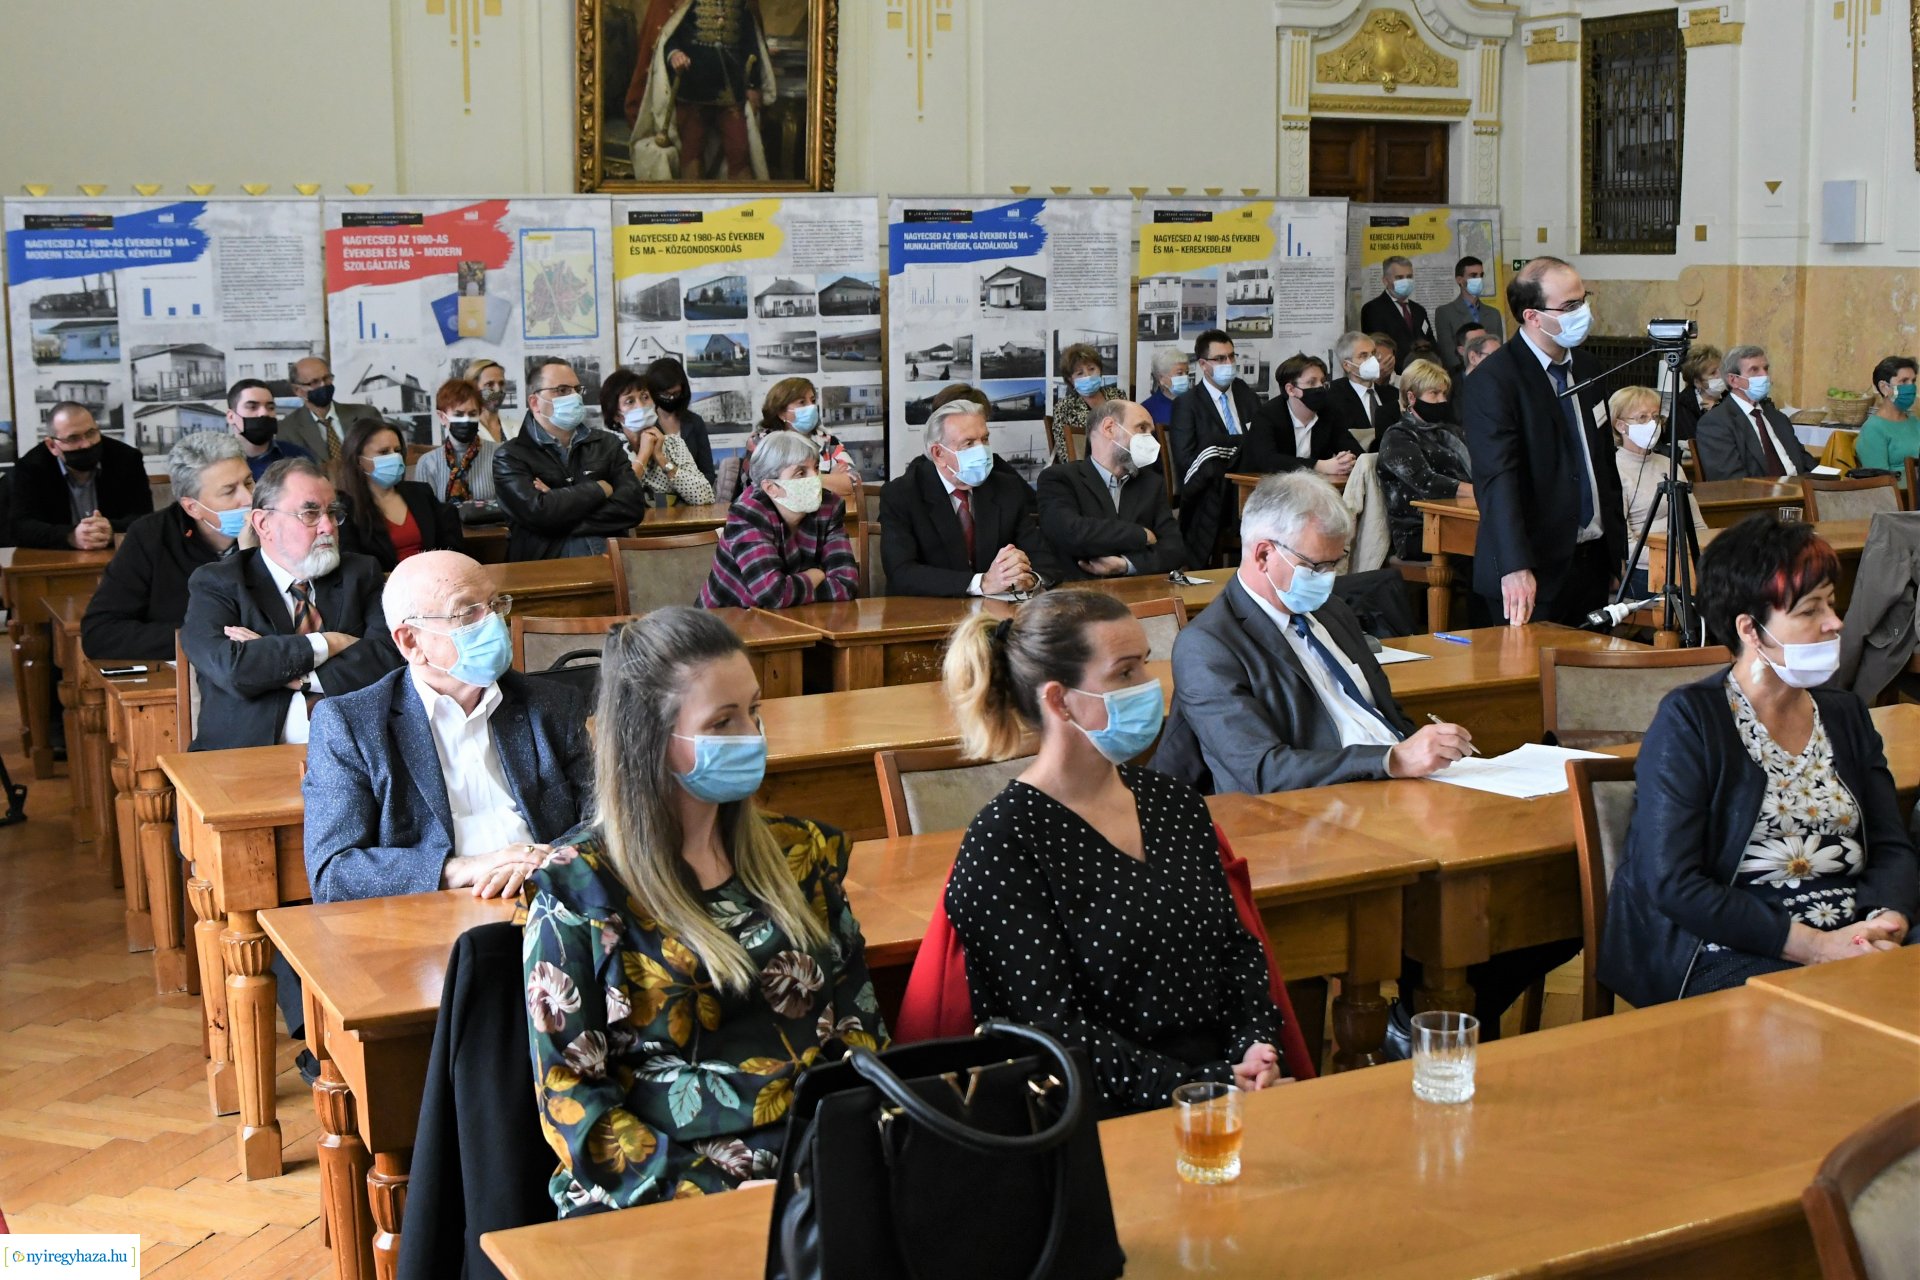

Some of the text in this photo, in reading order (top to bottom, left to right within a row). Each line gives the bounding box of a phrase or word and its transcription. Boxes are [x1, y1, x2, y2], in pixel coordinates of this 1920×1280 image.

[343, 234, 448, 245] NAGYECSED AZ 1980-AS
[630, 234, 677, 243] NAGYECSED
[693, 233, 726, 242] 1980-AS
[729, 231, 764, 240] ÉVEKBEN
[904, 232, 941, 240] NAGYECSED
[980, 231, 1007, 240] ÉVEKBEN
[1009, 230, 1016, 239] ÉS
[1232, 234, 1259, 242] ÉVEKBEN
[25, 239, 74, 249] NAGYECSED
[76, 239, 88, 248] AZ
[125, 237, 161, 247] ÉVEKBEN
[163, 237, 174, 246] ÉS
[973, 241, 1018, 249] GAZDÁLKODÁS
[26, 250, 62, 259] MODERN
[128, 248, 172, 258] KÉNYELEM
[343, 247, 383, 258] ÉVEKBEN
[386, 247, 397, 257] ÉS
[400, 248, 414, 257] MA
[424, 247, 462, 256] MODERN
[630, 245, 640, 255] ÉS
[666, 244, 742, 254] KÖZGONDOSKODÁS
[1154, 245, 1161, 253] ÉS
[344, 260, 410, 271] SZOLGÁLTATÁS
